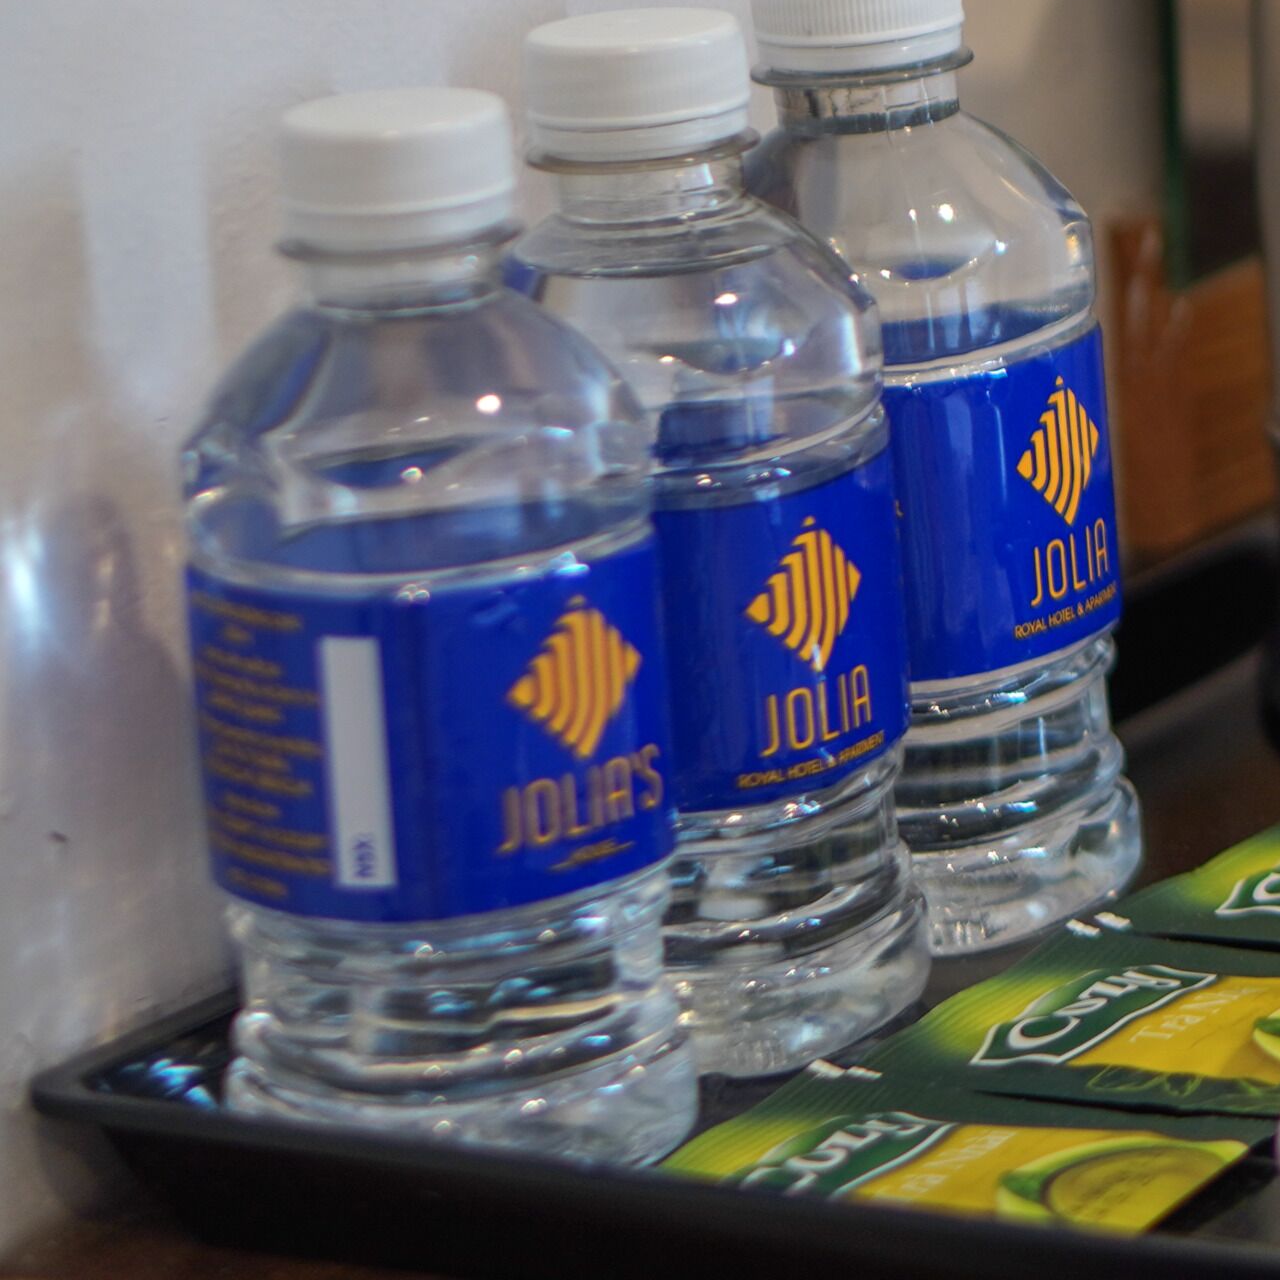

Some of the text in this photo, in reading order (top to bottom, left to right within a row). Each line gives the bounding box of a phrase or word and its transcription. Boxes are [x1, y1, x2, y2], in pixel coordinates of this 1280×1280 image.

[1031, 517, 1109, 608] JOLIA
[1015, 616, 1047, 639] ROYAL
[1048, 606, 1076, 627] HOTEL
[1077, 601, 1084, 616] &
[761, 664, 872, 758] JOLIA
[738, 769, 785, 788] ROYAL
[788, 758, 826, 779] HOTEL
[1005, 965, 1184, 1050] Cozy
